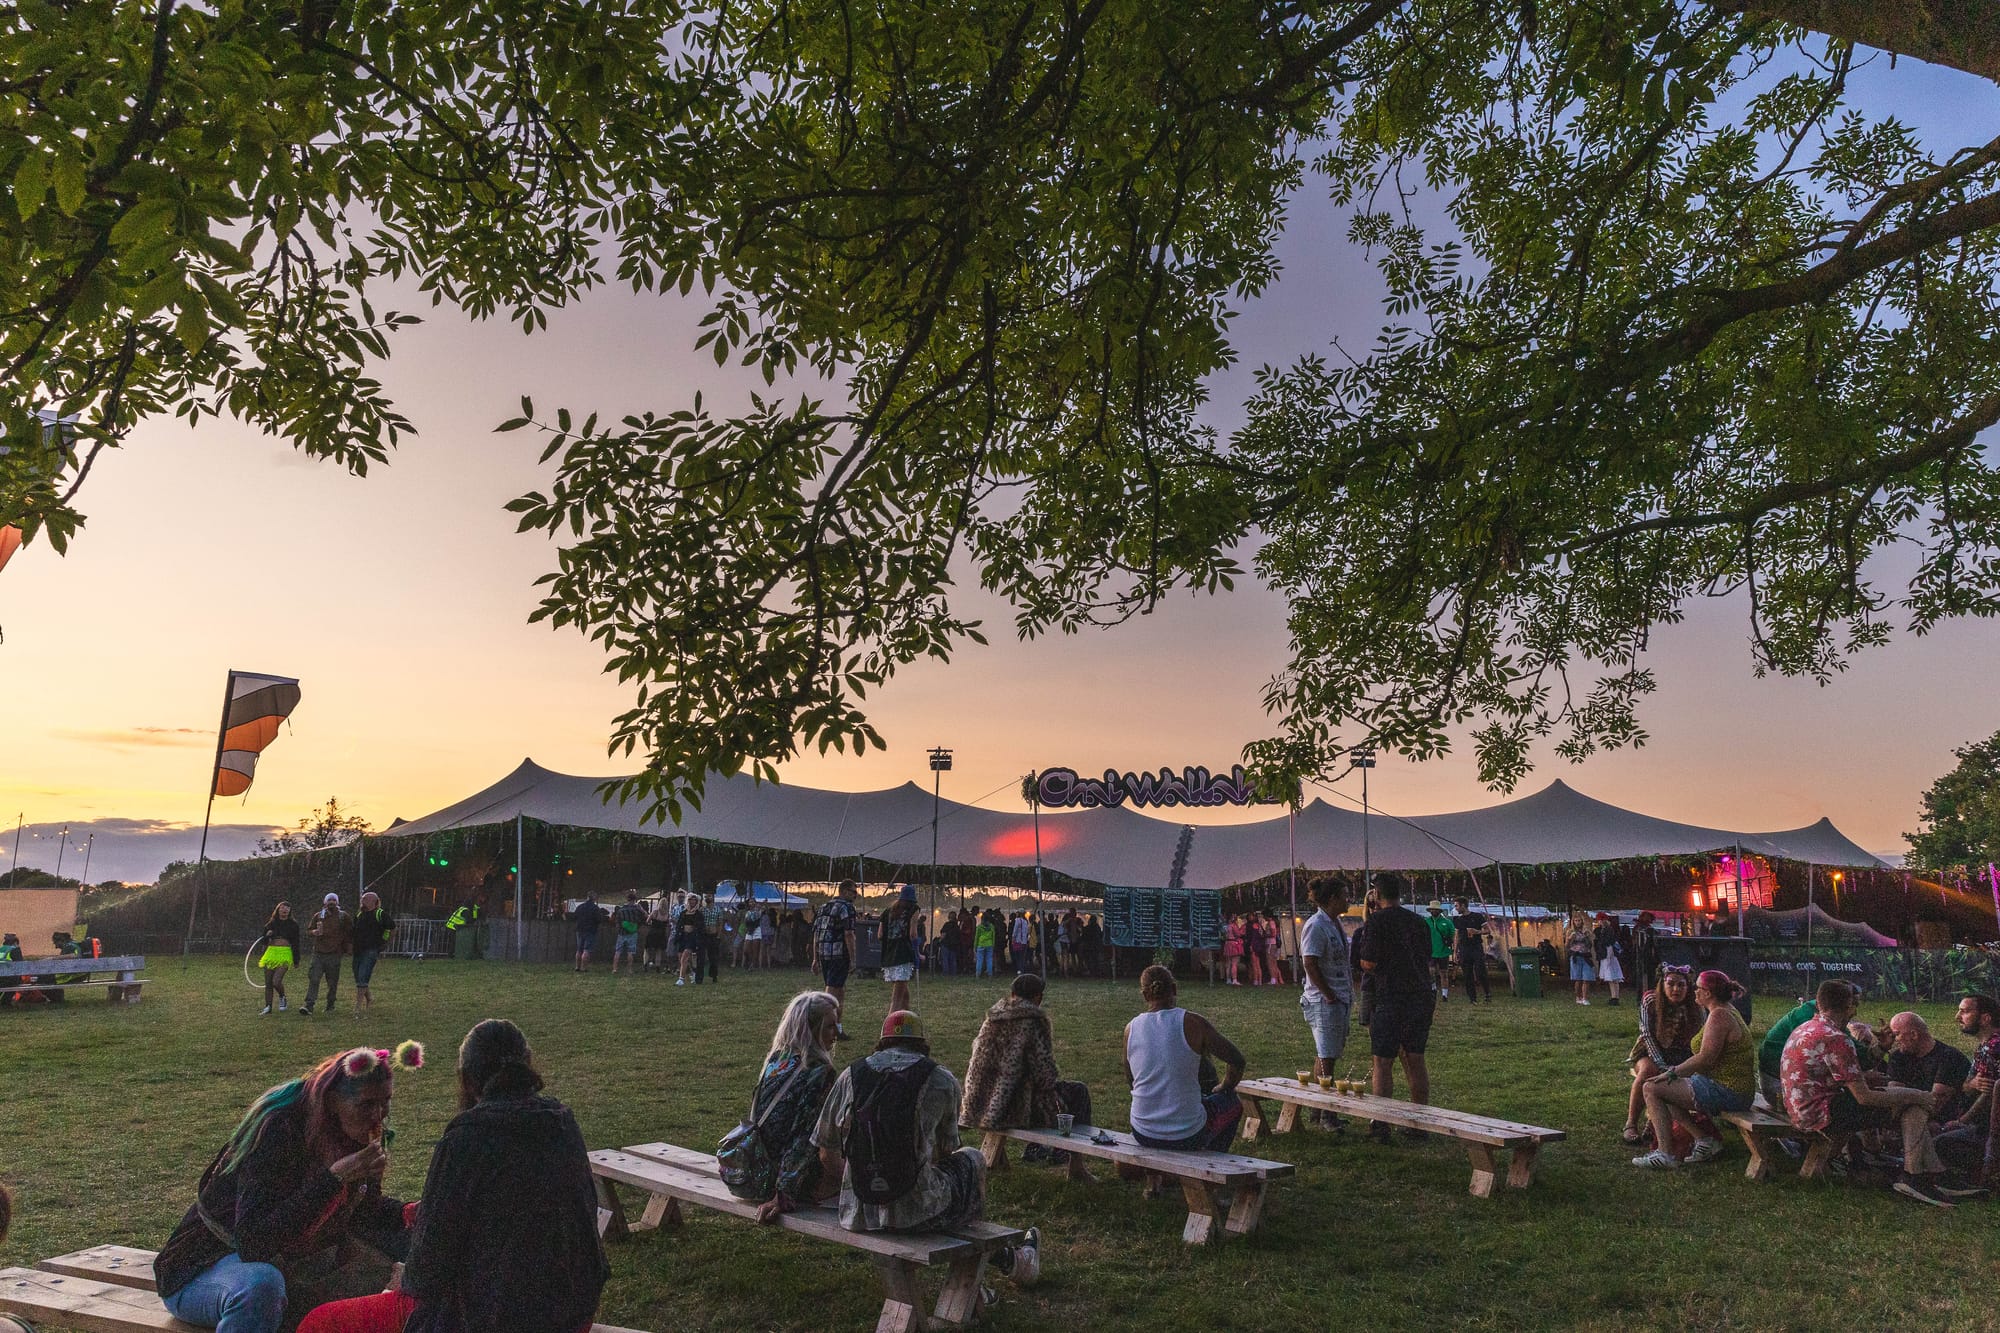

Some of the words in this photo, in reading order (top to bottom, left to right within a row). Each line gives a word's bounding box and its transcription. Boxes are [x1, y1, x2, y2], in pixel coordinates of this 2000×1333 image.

[1126, 765, 1283, 806] Wallah
[1750, 961, 1766, 970] GOOD
[1796, 962, 1817, 971] COME
[1821, 961, 1864, 972] TOGETHER
